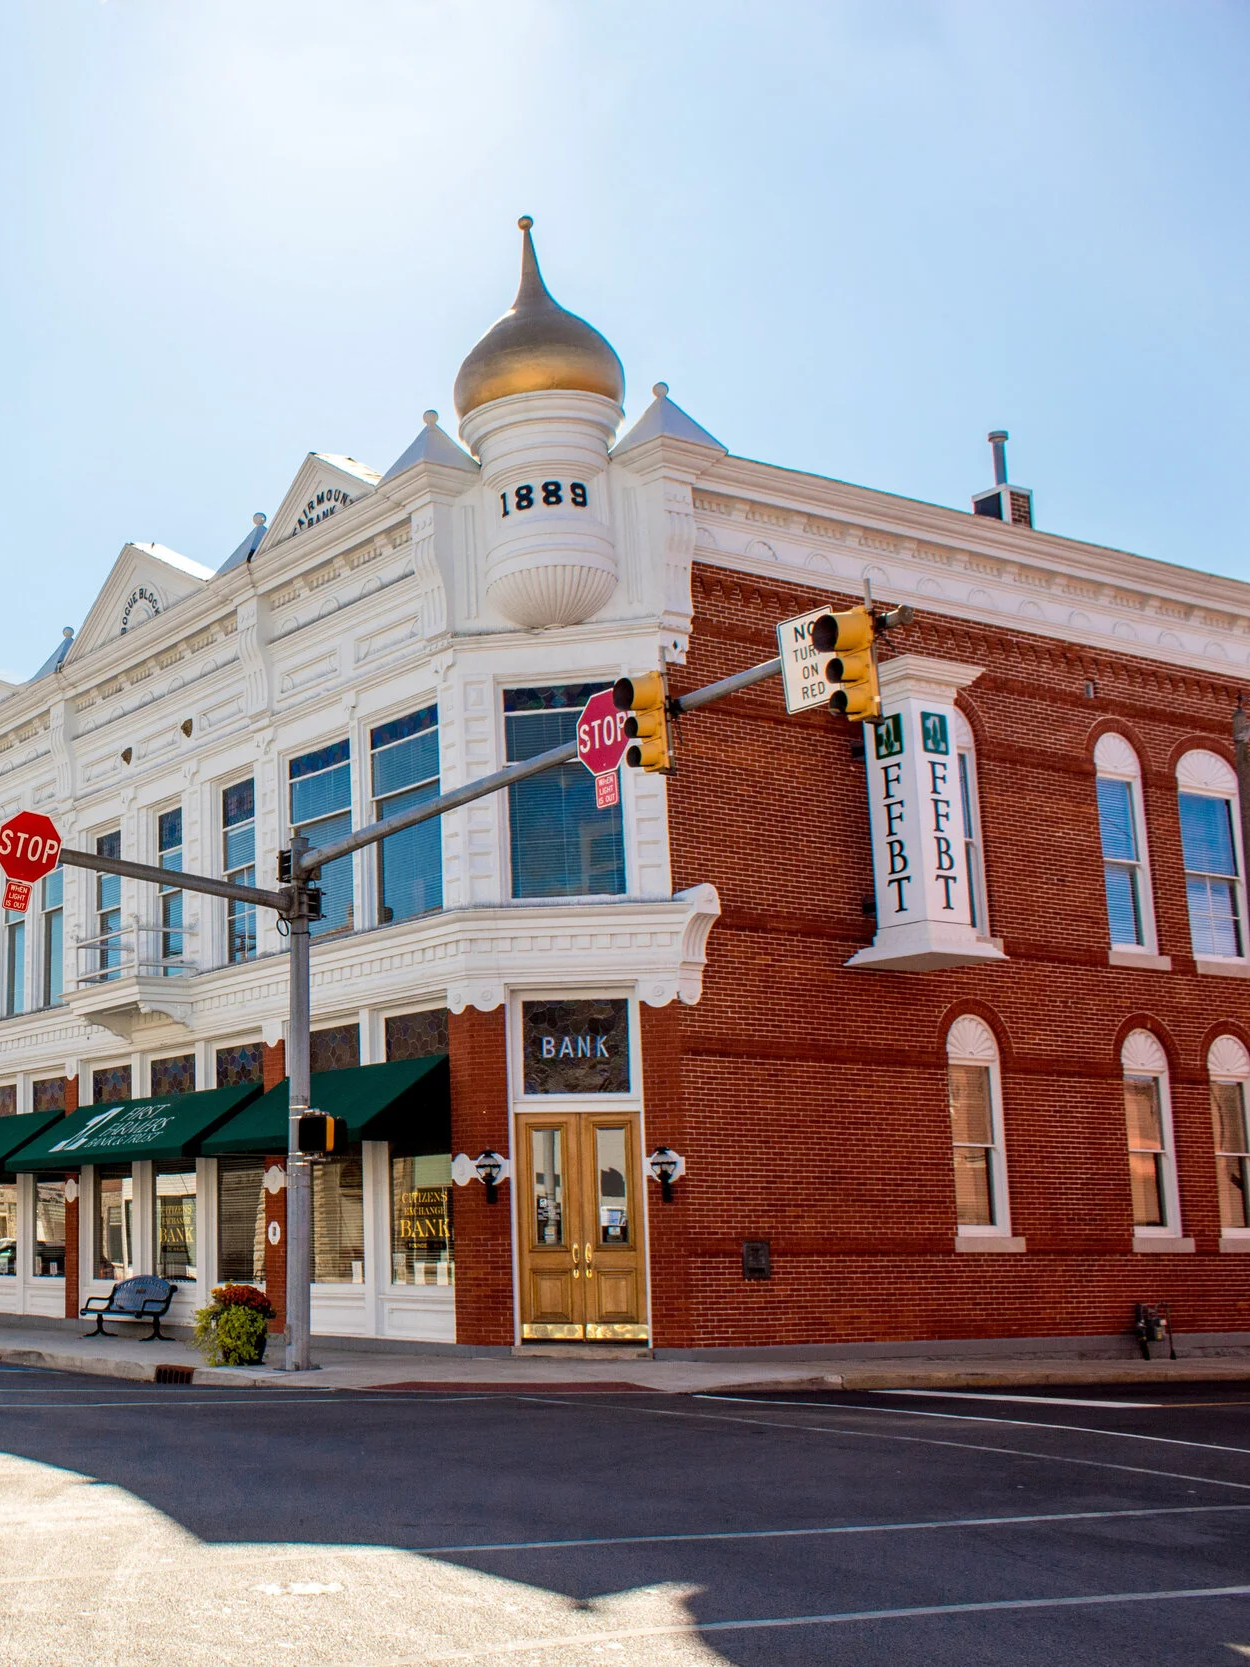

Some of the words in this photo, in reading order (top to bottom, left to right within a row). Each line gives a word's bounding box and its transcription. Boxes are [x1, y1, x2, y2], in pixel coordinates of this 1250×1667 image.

[500, 481, 588, 518] 1889
[293, 488, 354, 537] AIRMOUN
[308, 505, 336, 528] BANK
[121, 592, 138, 636] BOGUE
[139, 588, 161, 616] BLOCK
[793, 645, 820, 662] TUR
[802, 663, 819, 680] ON
[802, 681, 826, 700] RED
[579, 711, 626, 753] STOP
[598, 784, 614, 796] LIGHT
[605, 793, 615, 803] OUT
[881, 762, 912, 913] FFBT
[927, 760, 957, 911] FFBT
[8, 892, 26, 902] LIGHT
[10, 884, 28, 894] WHEN
[5, 899, 12, 907] IS
[13, 901, 26, 910] OUT
[541, 1035, 609, 1058] BANK
[120, 1103, 171, 1121] FIRST
[99, 1117, 175, 1137] FARMERS
[123, 1132, 164, 1144] TRUST
[402, 1191, 448, 1203] CITIZENS
[404, 1206, 446, 1216] EXCHANGE
[159, 1227, 194, 1243] BANK
[400, 1219, 450, 1238] BANK
